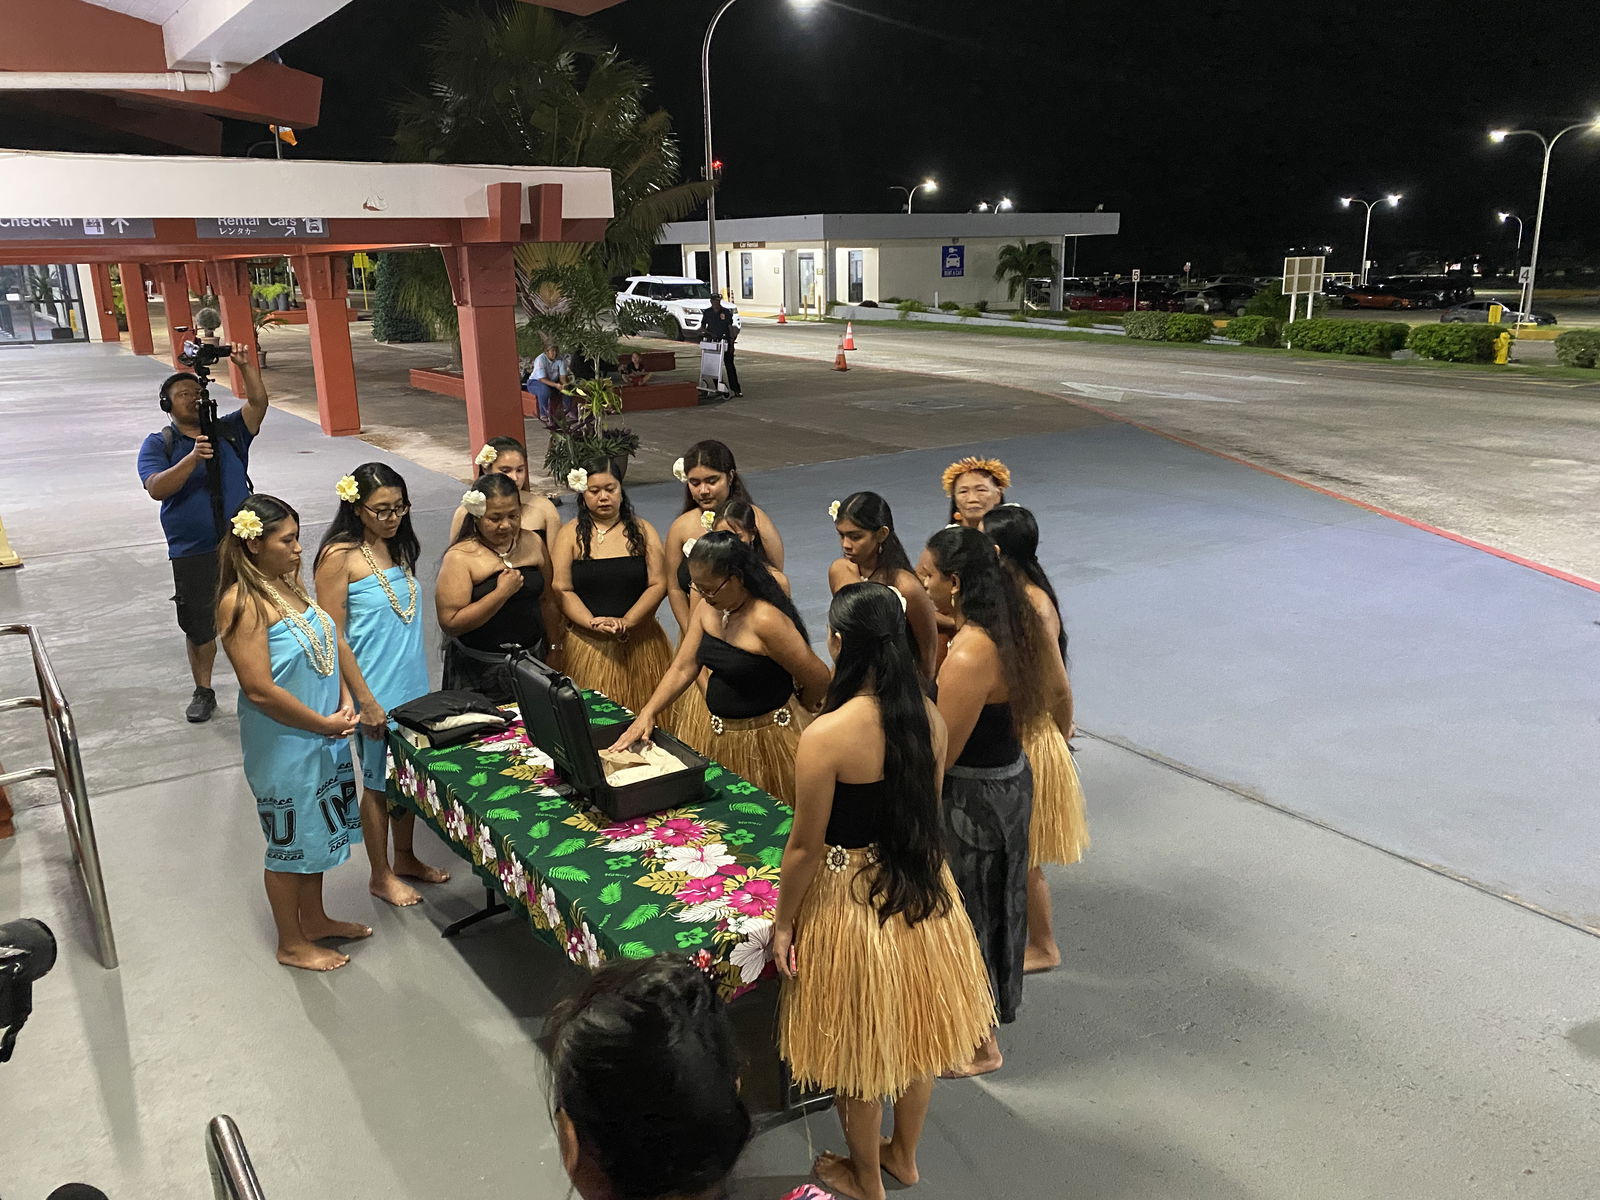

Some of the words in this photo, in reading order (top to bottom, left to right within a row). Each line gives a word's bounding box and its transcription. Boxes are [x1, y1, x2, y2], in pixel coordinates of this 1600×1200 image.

[217, 217, 260, 226] Rental
[267, 217, 297, 226] Cars
[219, 228, 257, 236] レンタカー
[1133, 271, 1139, 280] 5
[1521, 269, 1529, 281] 4
